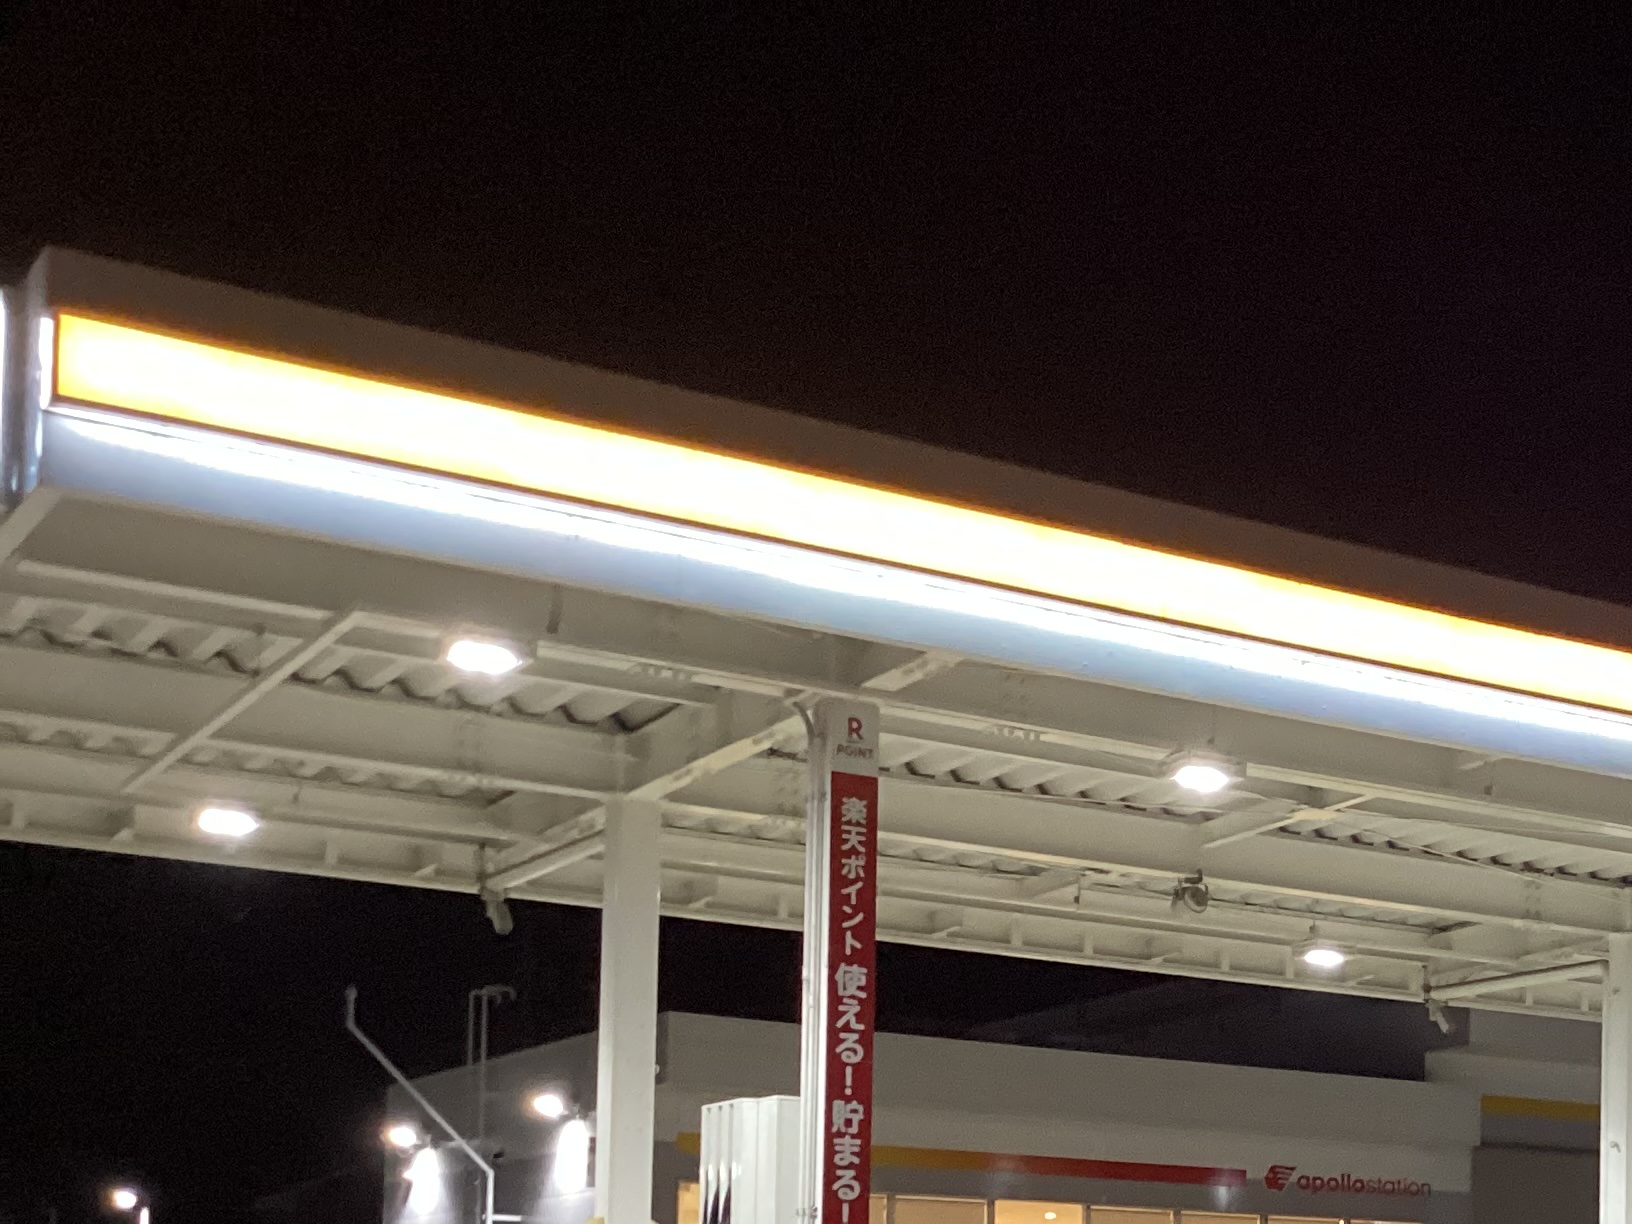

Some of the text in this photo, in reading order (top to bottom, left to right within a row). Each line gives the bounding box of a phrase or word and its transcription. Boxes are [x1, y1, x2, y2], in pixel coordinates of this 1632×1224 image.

[848, 717, 864, 740] R
[836, 744, 873, 758] POINT
[841, 797, 867, 956] 楽天ポイント
[1296, 1173, 1432, 1197] apollostation
